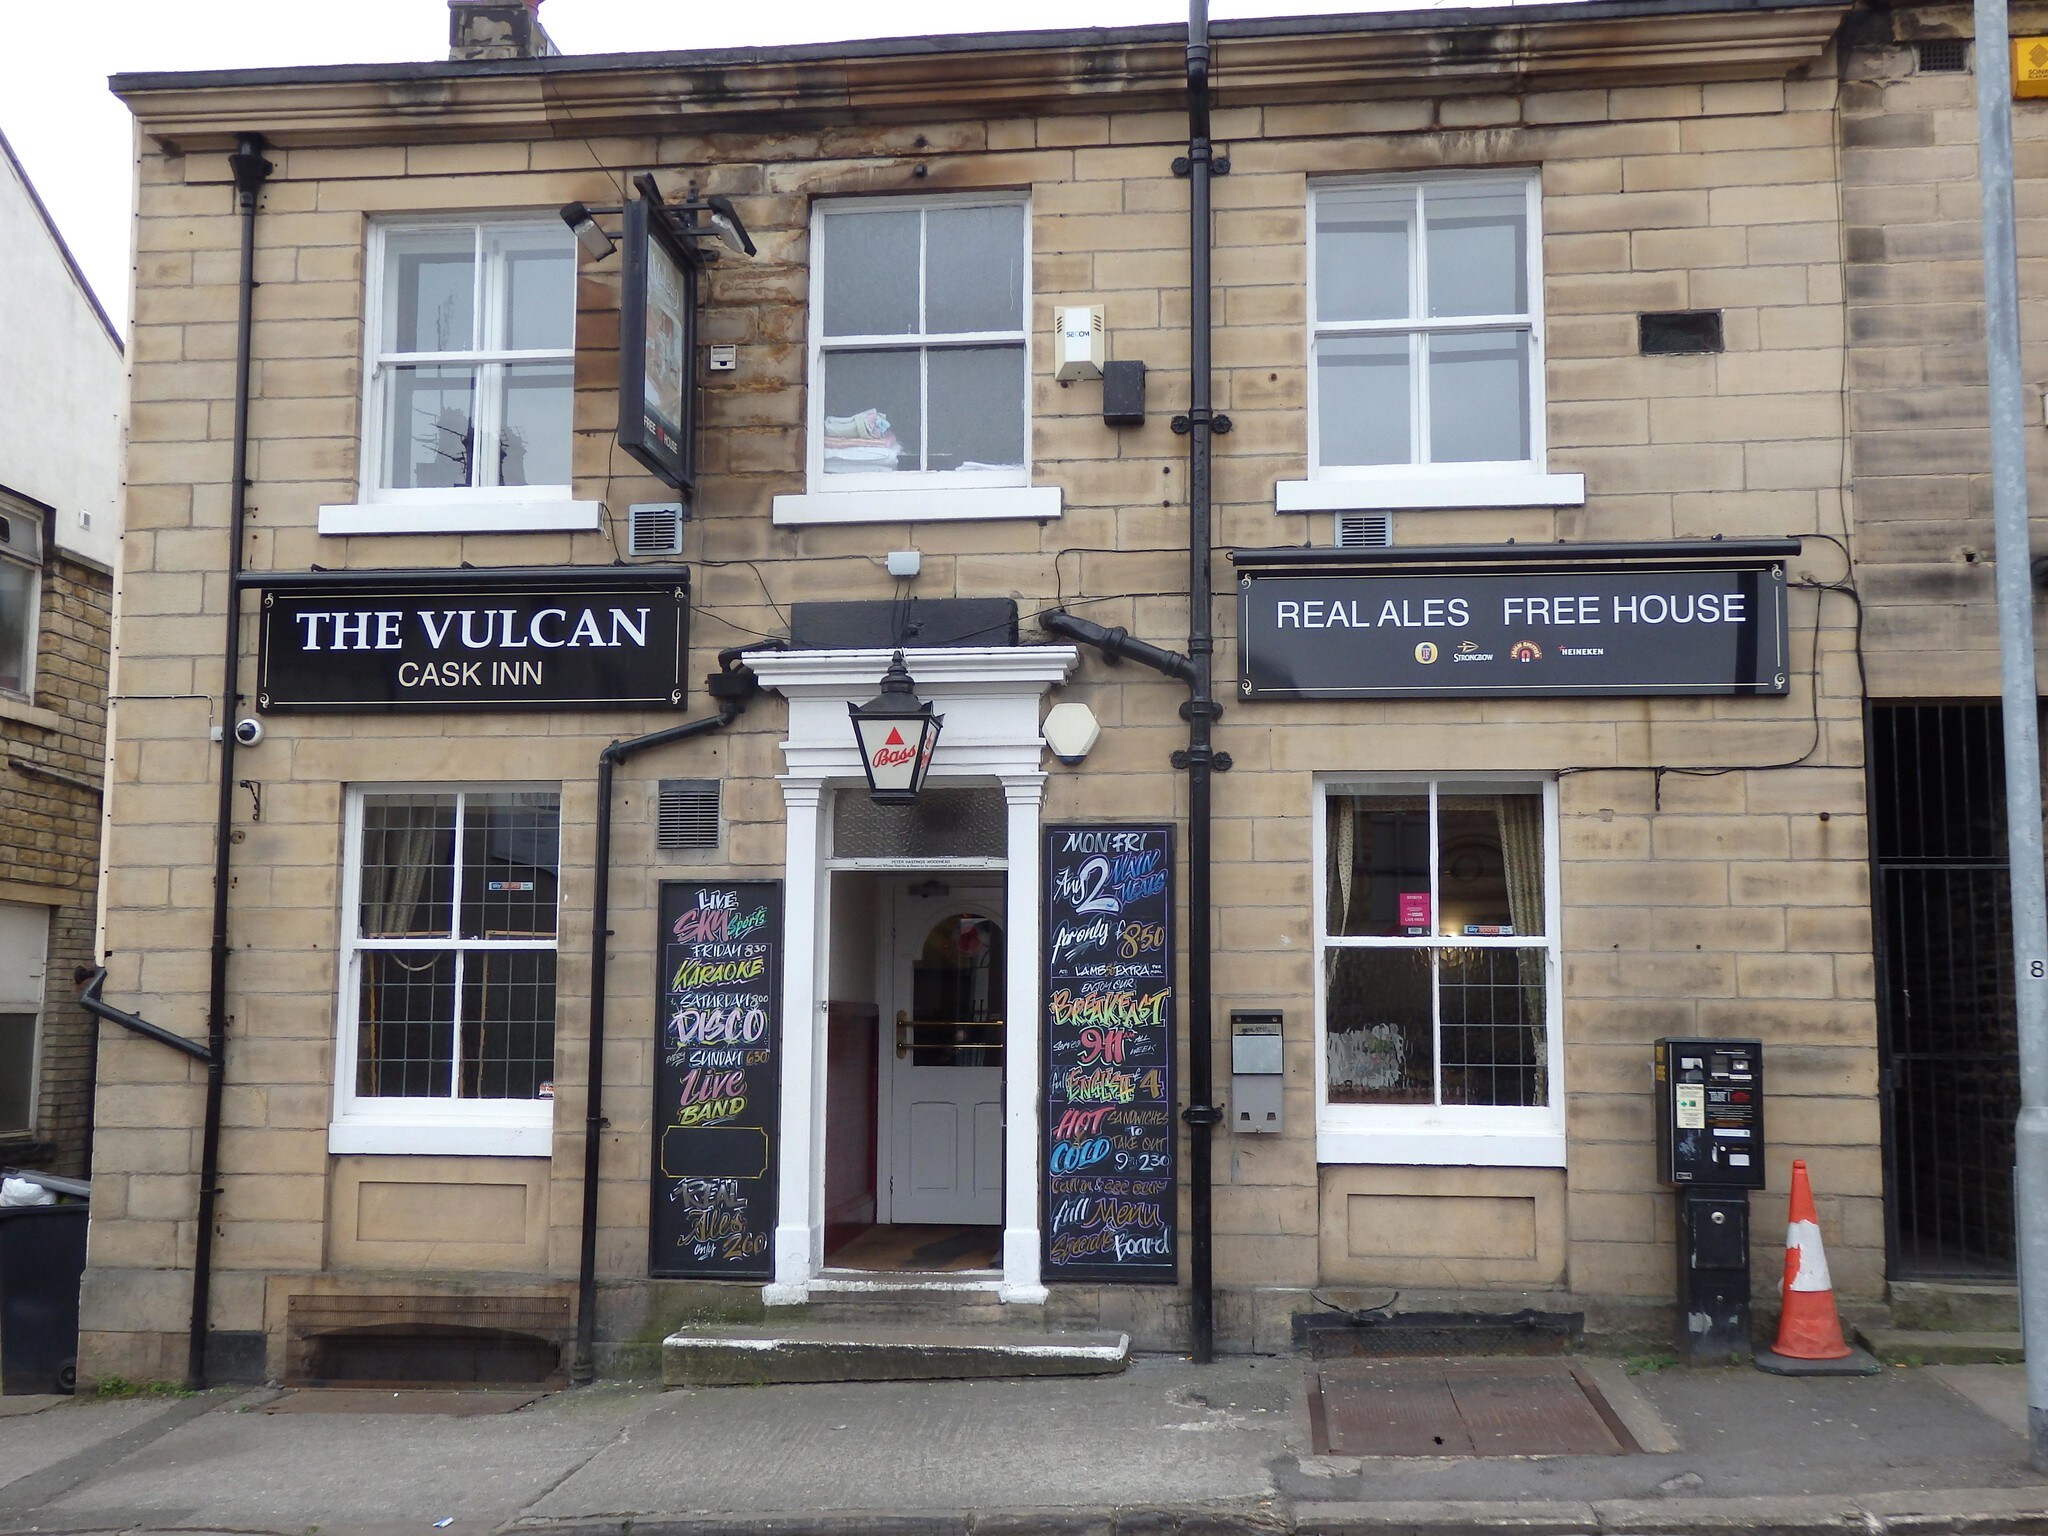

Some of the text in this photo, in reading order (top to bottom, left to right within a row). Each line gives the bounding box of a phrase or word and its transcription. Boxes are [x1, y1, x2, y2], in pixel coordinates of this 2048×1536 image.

[643, 415, 678, 454] FREE HOUSE
[1276, 593, 1746, 628] REAL ALES FREE HOUSE
[296, 608, 651, 650] THE VULCAN
[1453, 653, 1494, 662] STRONGBOW
[1561, 648, 1604, 656] HEINEKEN
[398, 661, 542, 687] CASK INN
[872, 745, 916, 768] Bass
[697, 890, 737, 910] LIVE
[1053, 868, 1085, 905] Any
[1076, 857, 1120, 914] 2
[727, 909, 766, 936] Sports
[1468, 926, 1479, 934] sky
[692, 943, 742, 958] FRIDAY
[672, 957, 764, 991] KARAOKE
[1075, 963, 1106, 977] LAMB
[1115, 964, 1150, 977] EXTRA
[2030, 960, 2044, 978] 8
[680, 992, 750, 1008] SATURDAY
[1081, 980, 1112, 993] ENJOY
[1052, 988, 1170, 1027] BREAKFAST
[668, 1008, 766, 1042] DISCO
[689, 1050, 742, 1067] SUNDAY
[1068, 1067, 1135, 1104] ENGLISH
[679, 1096, 746, 1125] BAND
[1053, 1105, 1170, 1140] HOT SANDWICHES
[1050, 1136, 1167, 1173] COLD TAKE OUT
[675, 1179, 747, 1209] REAL
[1083, 1199, 1161, 1228] Menu
[1113, 1226, 1170, 1262] Board
